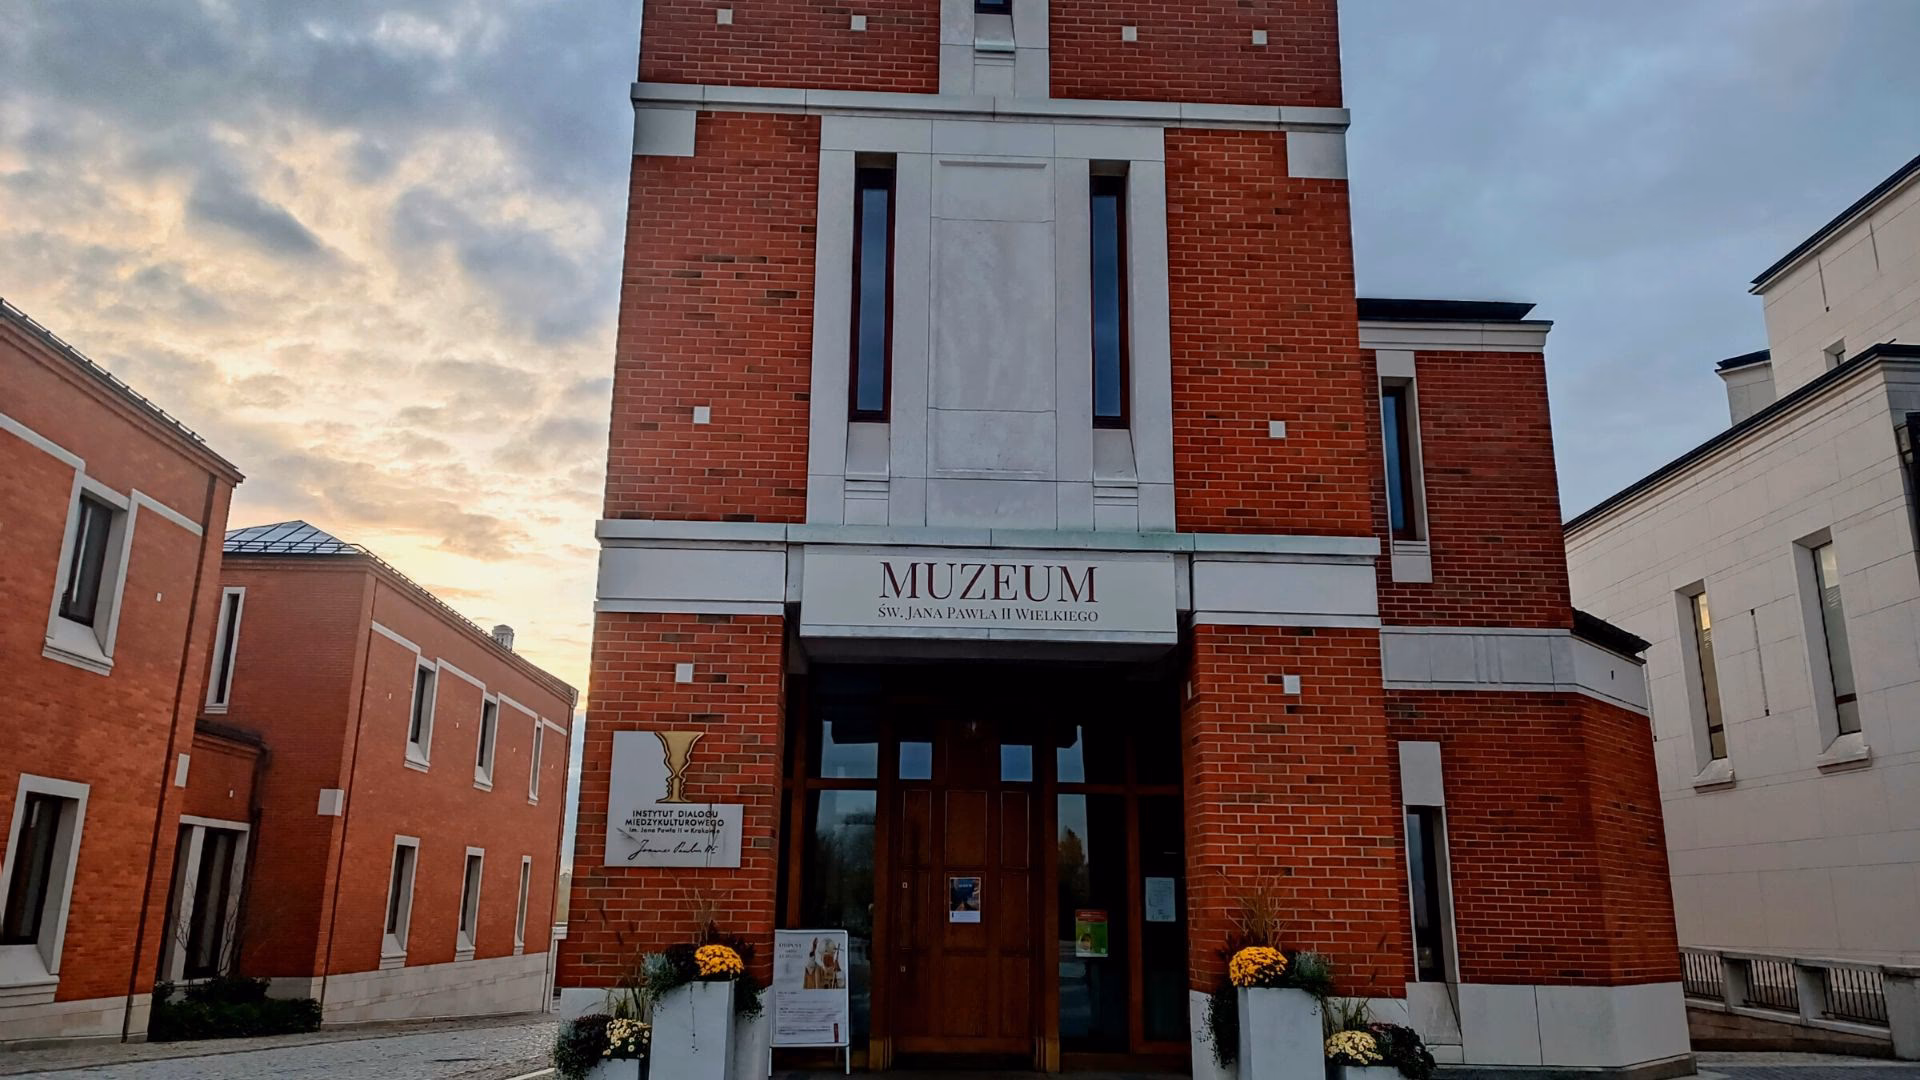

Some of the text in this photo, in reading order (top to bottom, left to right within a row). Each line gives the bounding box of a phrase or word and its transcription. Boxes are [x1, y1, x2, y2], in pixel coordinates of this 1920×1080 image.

[879, 562, 1099, 603] MUZEUM
[878, 604, 904, 618] ŚW.
[905, 607, 944, 620] JANA
[1001, 608, 1011, 620] II
[1015, 608, 1099, 622] WIELKIEGO
[632, 810, 718, 818] INSTYTUT DIALOGU
[625, 818, 724, 827] MIĘDZYKULTUROWEGO
